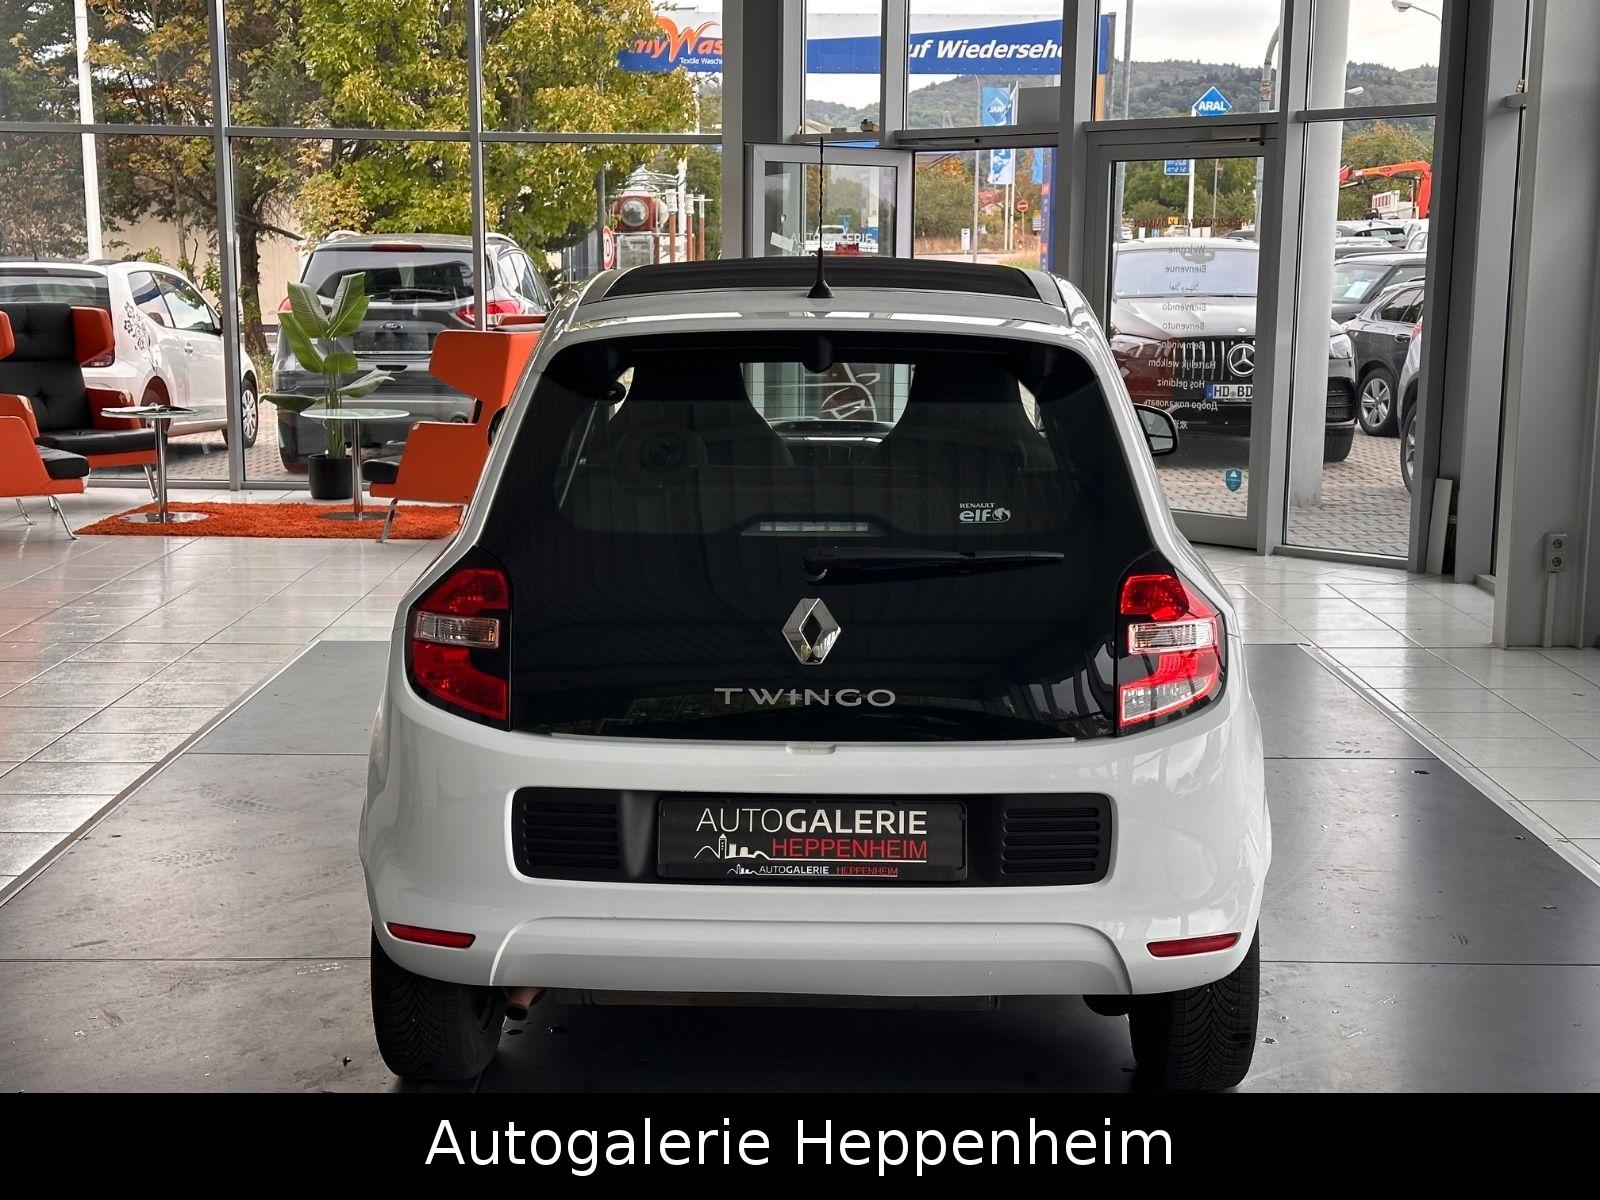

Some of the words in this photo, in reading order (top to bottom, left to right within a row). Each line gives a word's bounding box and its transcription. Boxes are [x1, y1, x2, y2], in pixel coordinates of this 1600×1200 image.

[1198, 101, 1227, 111] ARAL
[1213, 386, 1230, 398] HD
[959, 509, 992, 522] elf
[714, 687, 896, 707] TWINGO
[695, 807, 928, 835] AUTOGALERIE
[771, 837, 928, 860] HEPPENHEIM
[759, 865, 830, 875] AUTOGALERIE
[836, 866, 899, 876] HEPPENHEIM
